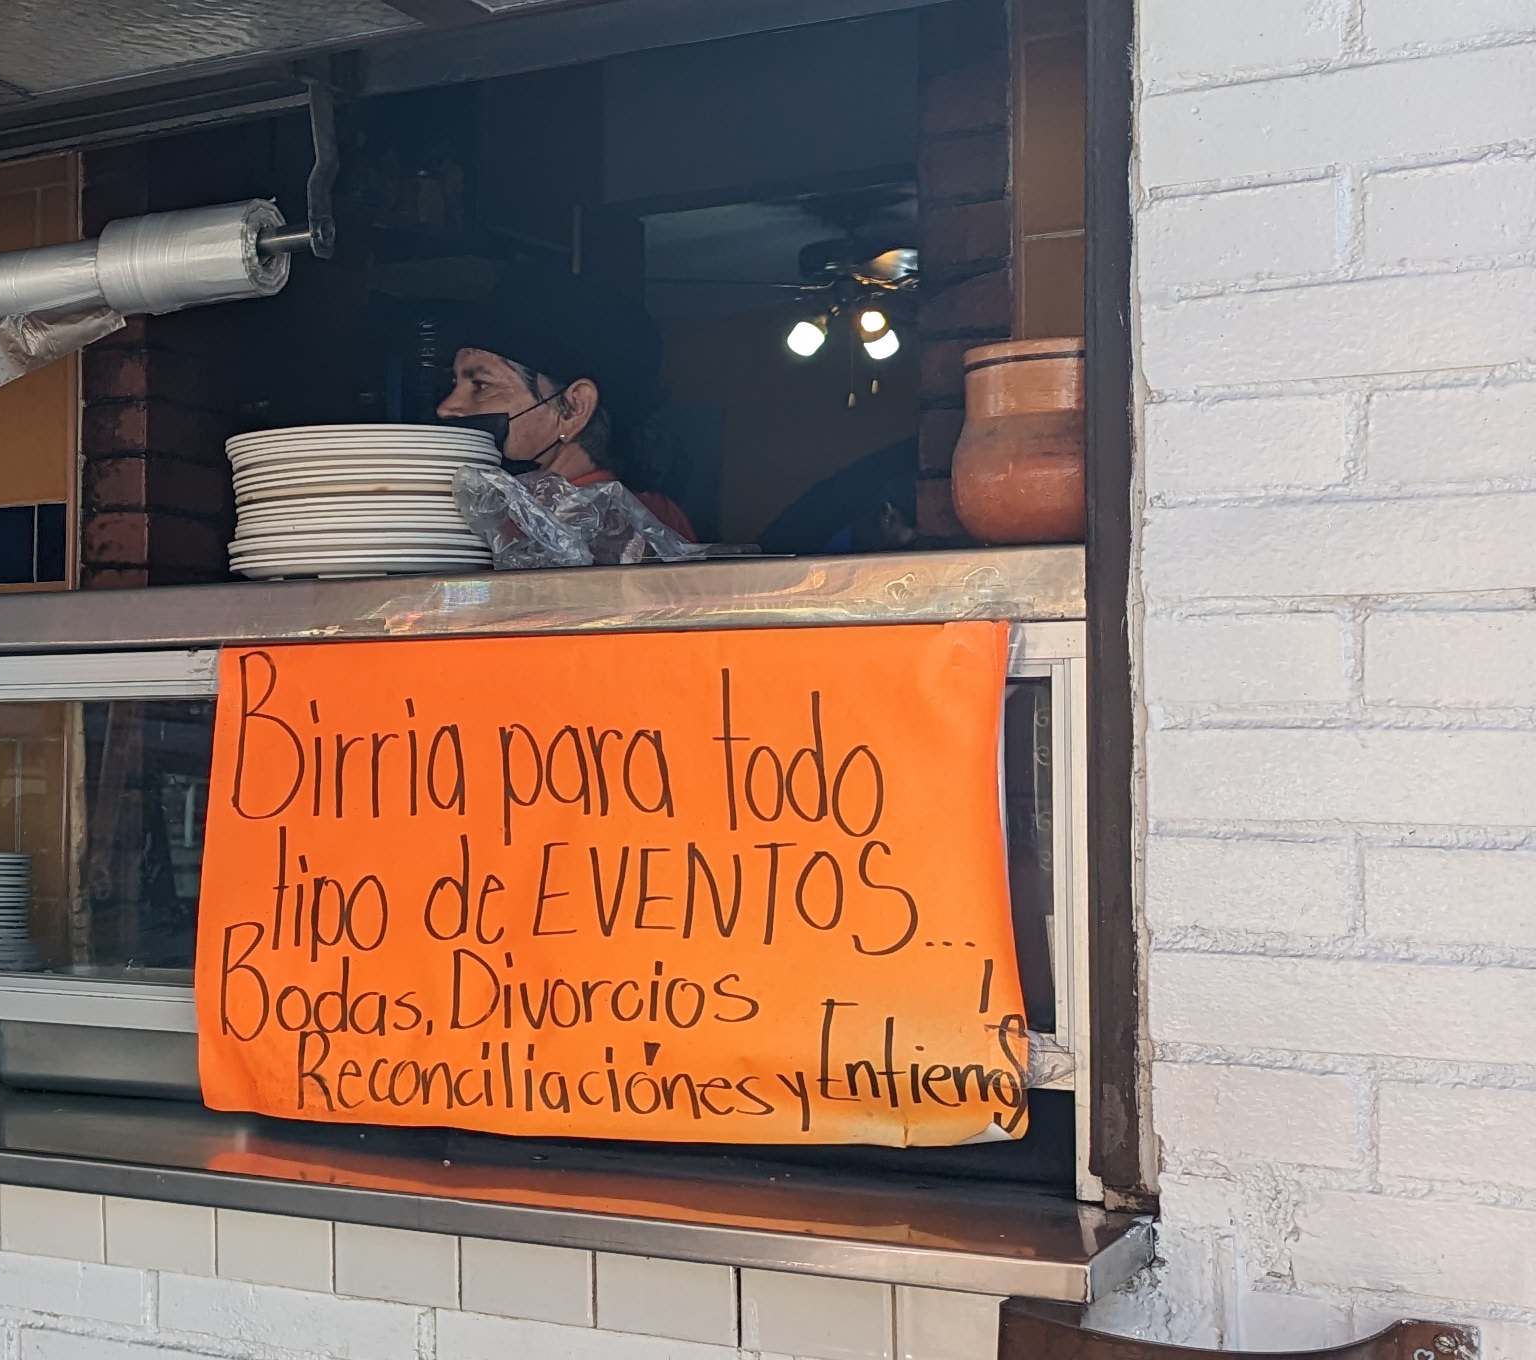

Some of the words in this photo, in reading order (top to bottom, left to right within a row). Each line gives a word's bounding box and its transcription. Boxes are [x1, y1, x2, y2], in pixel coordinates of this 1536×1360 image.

[232, 650, 465, 821] Birria
[500, 723, 674, 846] para
[713, 668, 884, 838] todo
[272, 826, 386, 963] tipo
[424, 834, 505, 946] de
[220, 922, 434, 1043] Bodas,
[450, 948, 761, 1032] Divorcios
[776, 1069, 813, 1133] y
